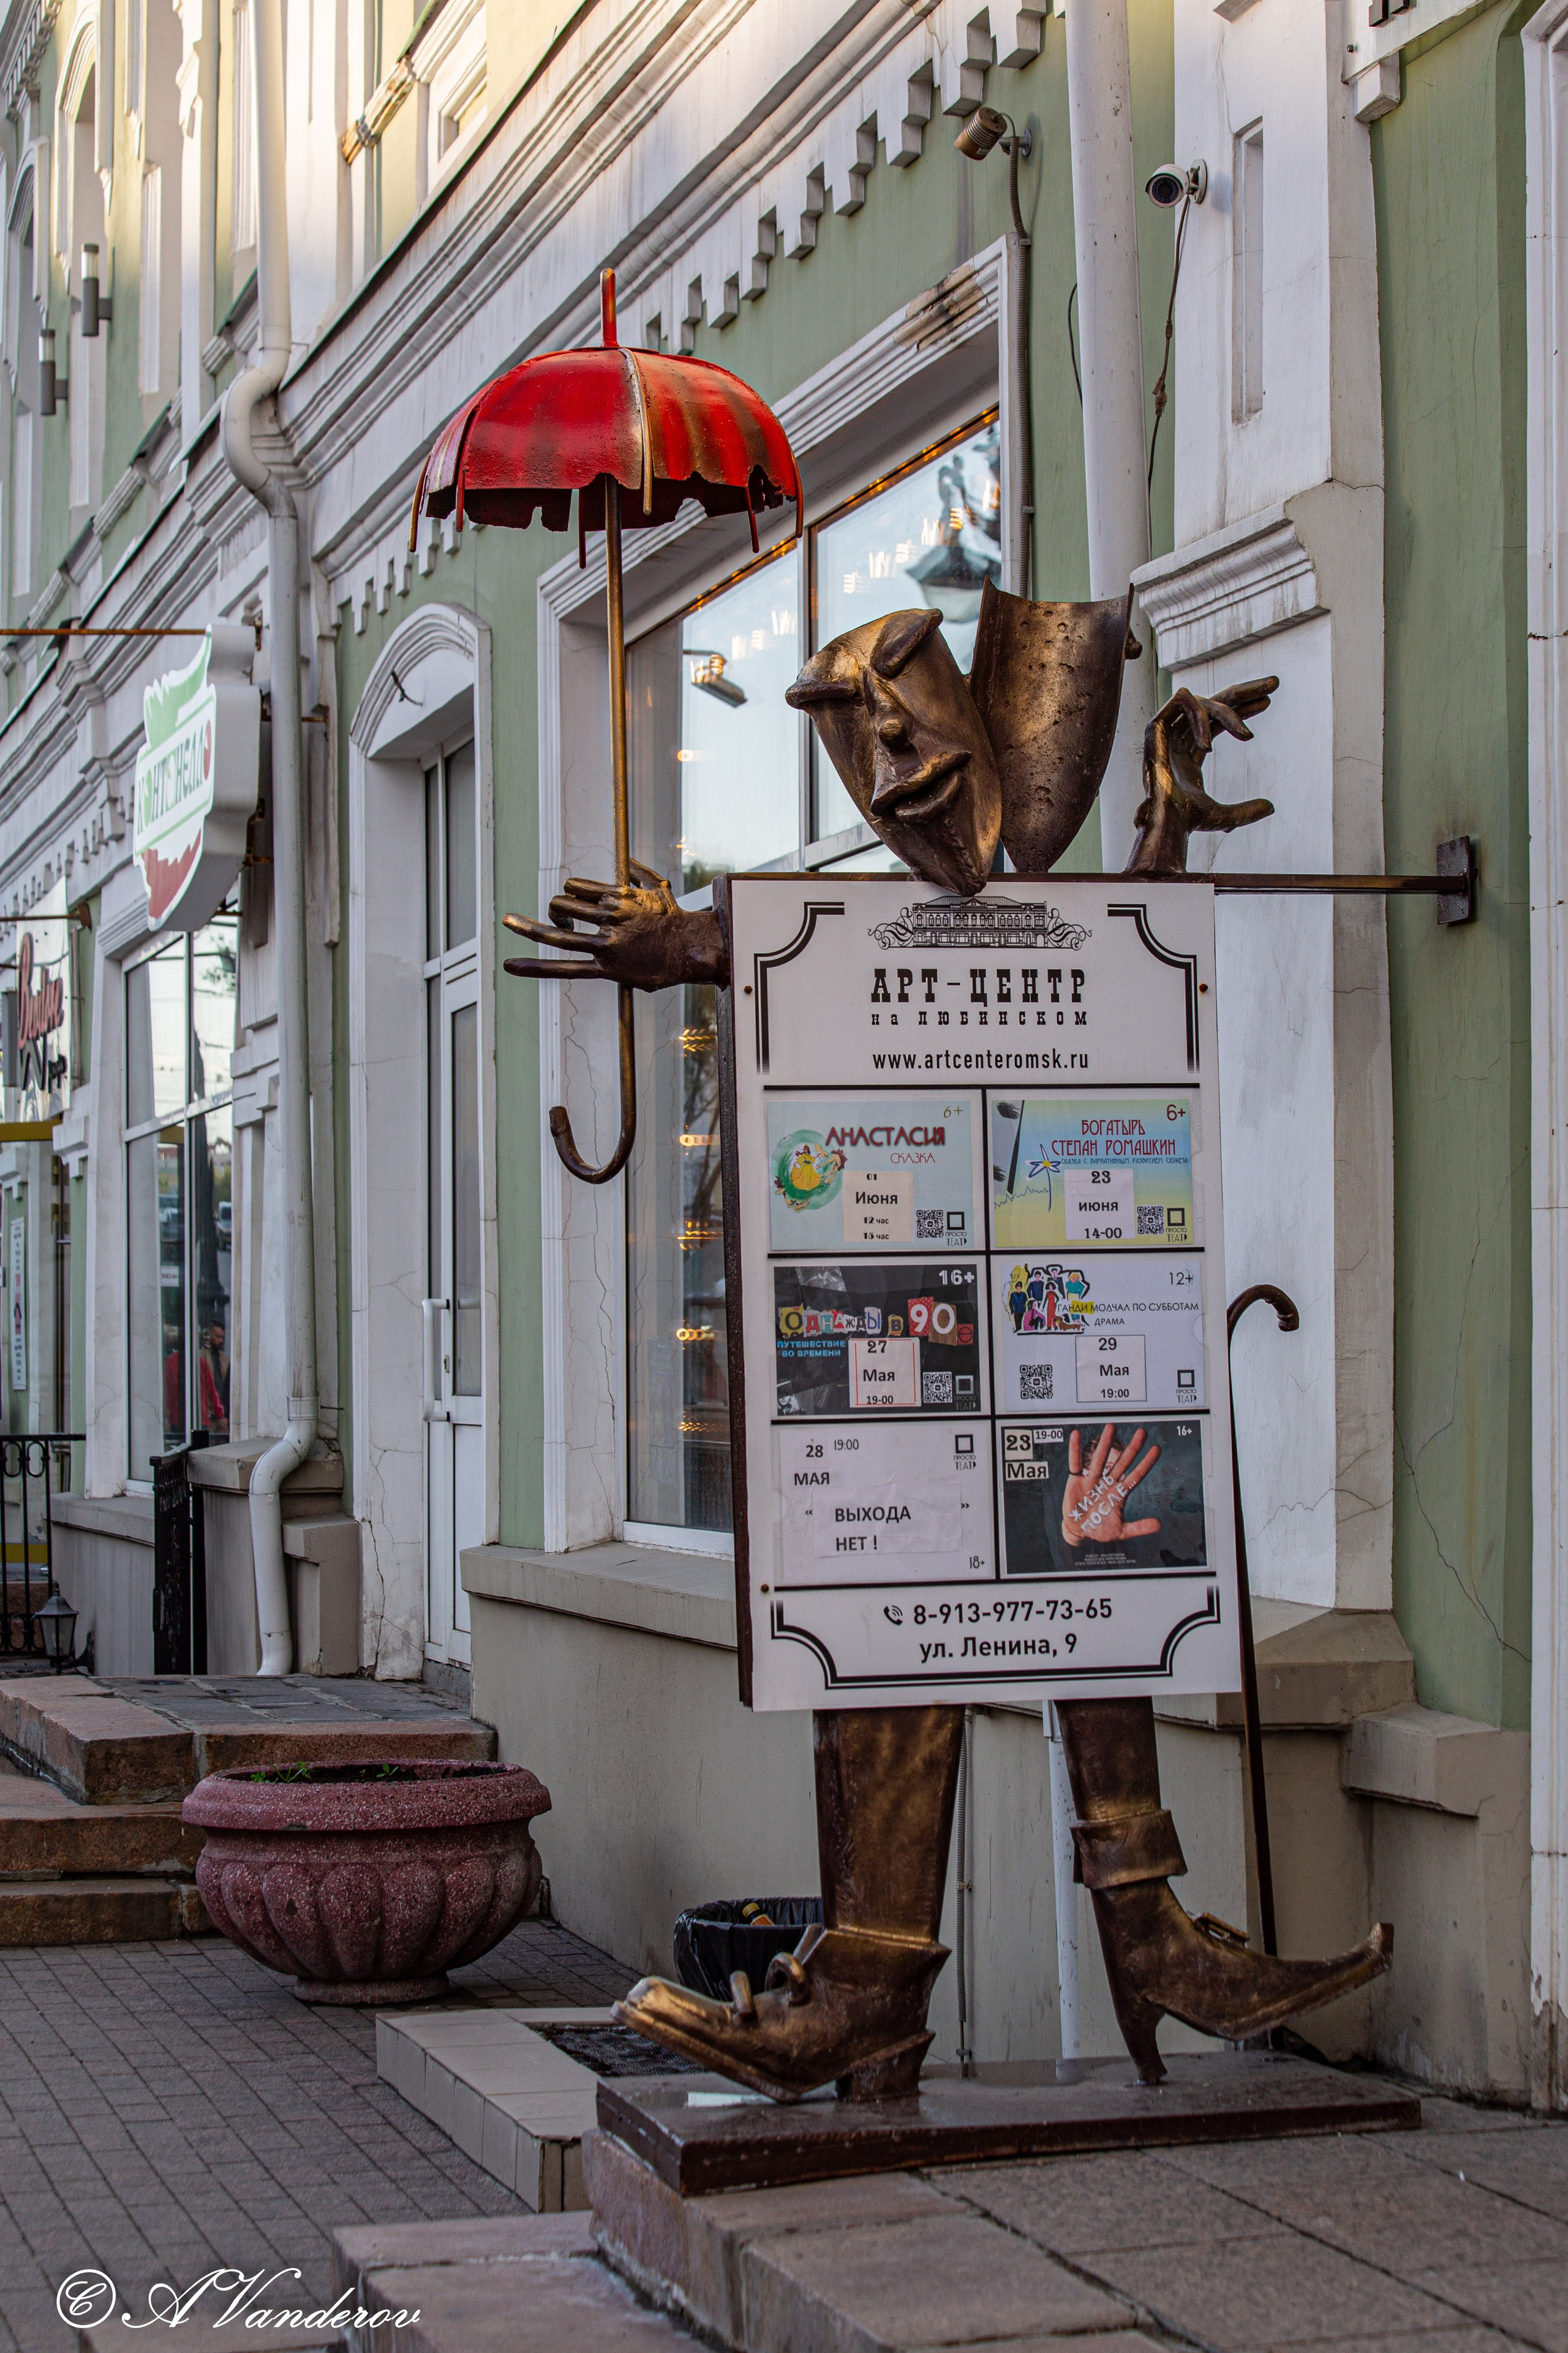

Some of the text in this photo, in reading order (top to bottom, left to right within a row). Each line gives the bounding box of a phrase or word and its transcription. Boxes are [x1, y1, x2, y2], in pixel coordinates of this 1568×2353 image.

[870, 968, 1085, 1007] АРТ-ЦЕНТР
[918, 1011, 1087, 1027] ЛЮБИНСКОМ
[873, 1048, 1088, 1070] www.artcenteromsk.ru
[943, 1105, 963, 1119] 6+
[1167, 1104, 1186, 1121] 6+
[1082, 1120, 1145, 1136] БОГАТЫРЬ
[826, 1127, 945, 1146] АНАСТАСИЯ
[1051, 1139, 1177, 1156] СТЕПАН РОМАШКИН
[890, 1152, 936, 1164] СКАЗКА
[1091, 1171, 1111, 1184] 23
[856, 1192, 898, 1204] Июня
[1085, 1228, 1122, 1239] 14-00
[939, 1269, 974, 1285] 16+
[1169, 1272, 1194, 1285] 12+
[1057, 1304, 1088, 1313] ГАНДИ
[1133, 1302, 1147, 1311] ПО
[1149, 1302, 1199, 1312] СУББОТАМ
[1095, 1318, 1125, 1326] ДРАМА
[867, 1340, 887, 1353] 27
[1098, 1337, 1117, 1350] 29
[862, 1369, 895, 1382] Мая
[1099, 1364, 1129, 1377] Мая
[866, 1396, 894, 1405] 19-00
[1100, 1389, 1129, 1398] 19:00
[1177, 1426, 1193, 1437] 16+
[805, 1438, 859, 1457] 28 19:00
[1006, 1430, 1063, 1451] 23 19-00
[1007, 1463, 1047, 1478] Мая
[794, 1472, 830, 1486] МАЯ
[1068, 1474, 1114, 1522] ЖИЗНЬ
[835, 1506, 911, 1523] ВЫХОДА
[835, 1536, 867, 1551] НЕТ
[913, 1598, 1112, 1625] 8-913-977-73-65
[919, 1634, 1077, 1663] ул. Ленина, 9
